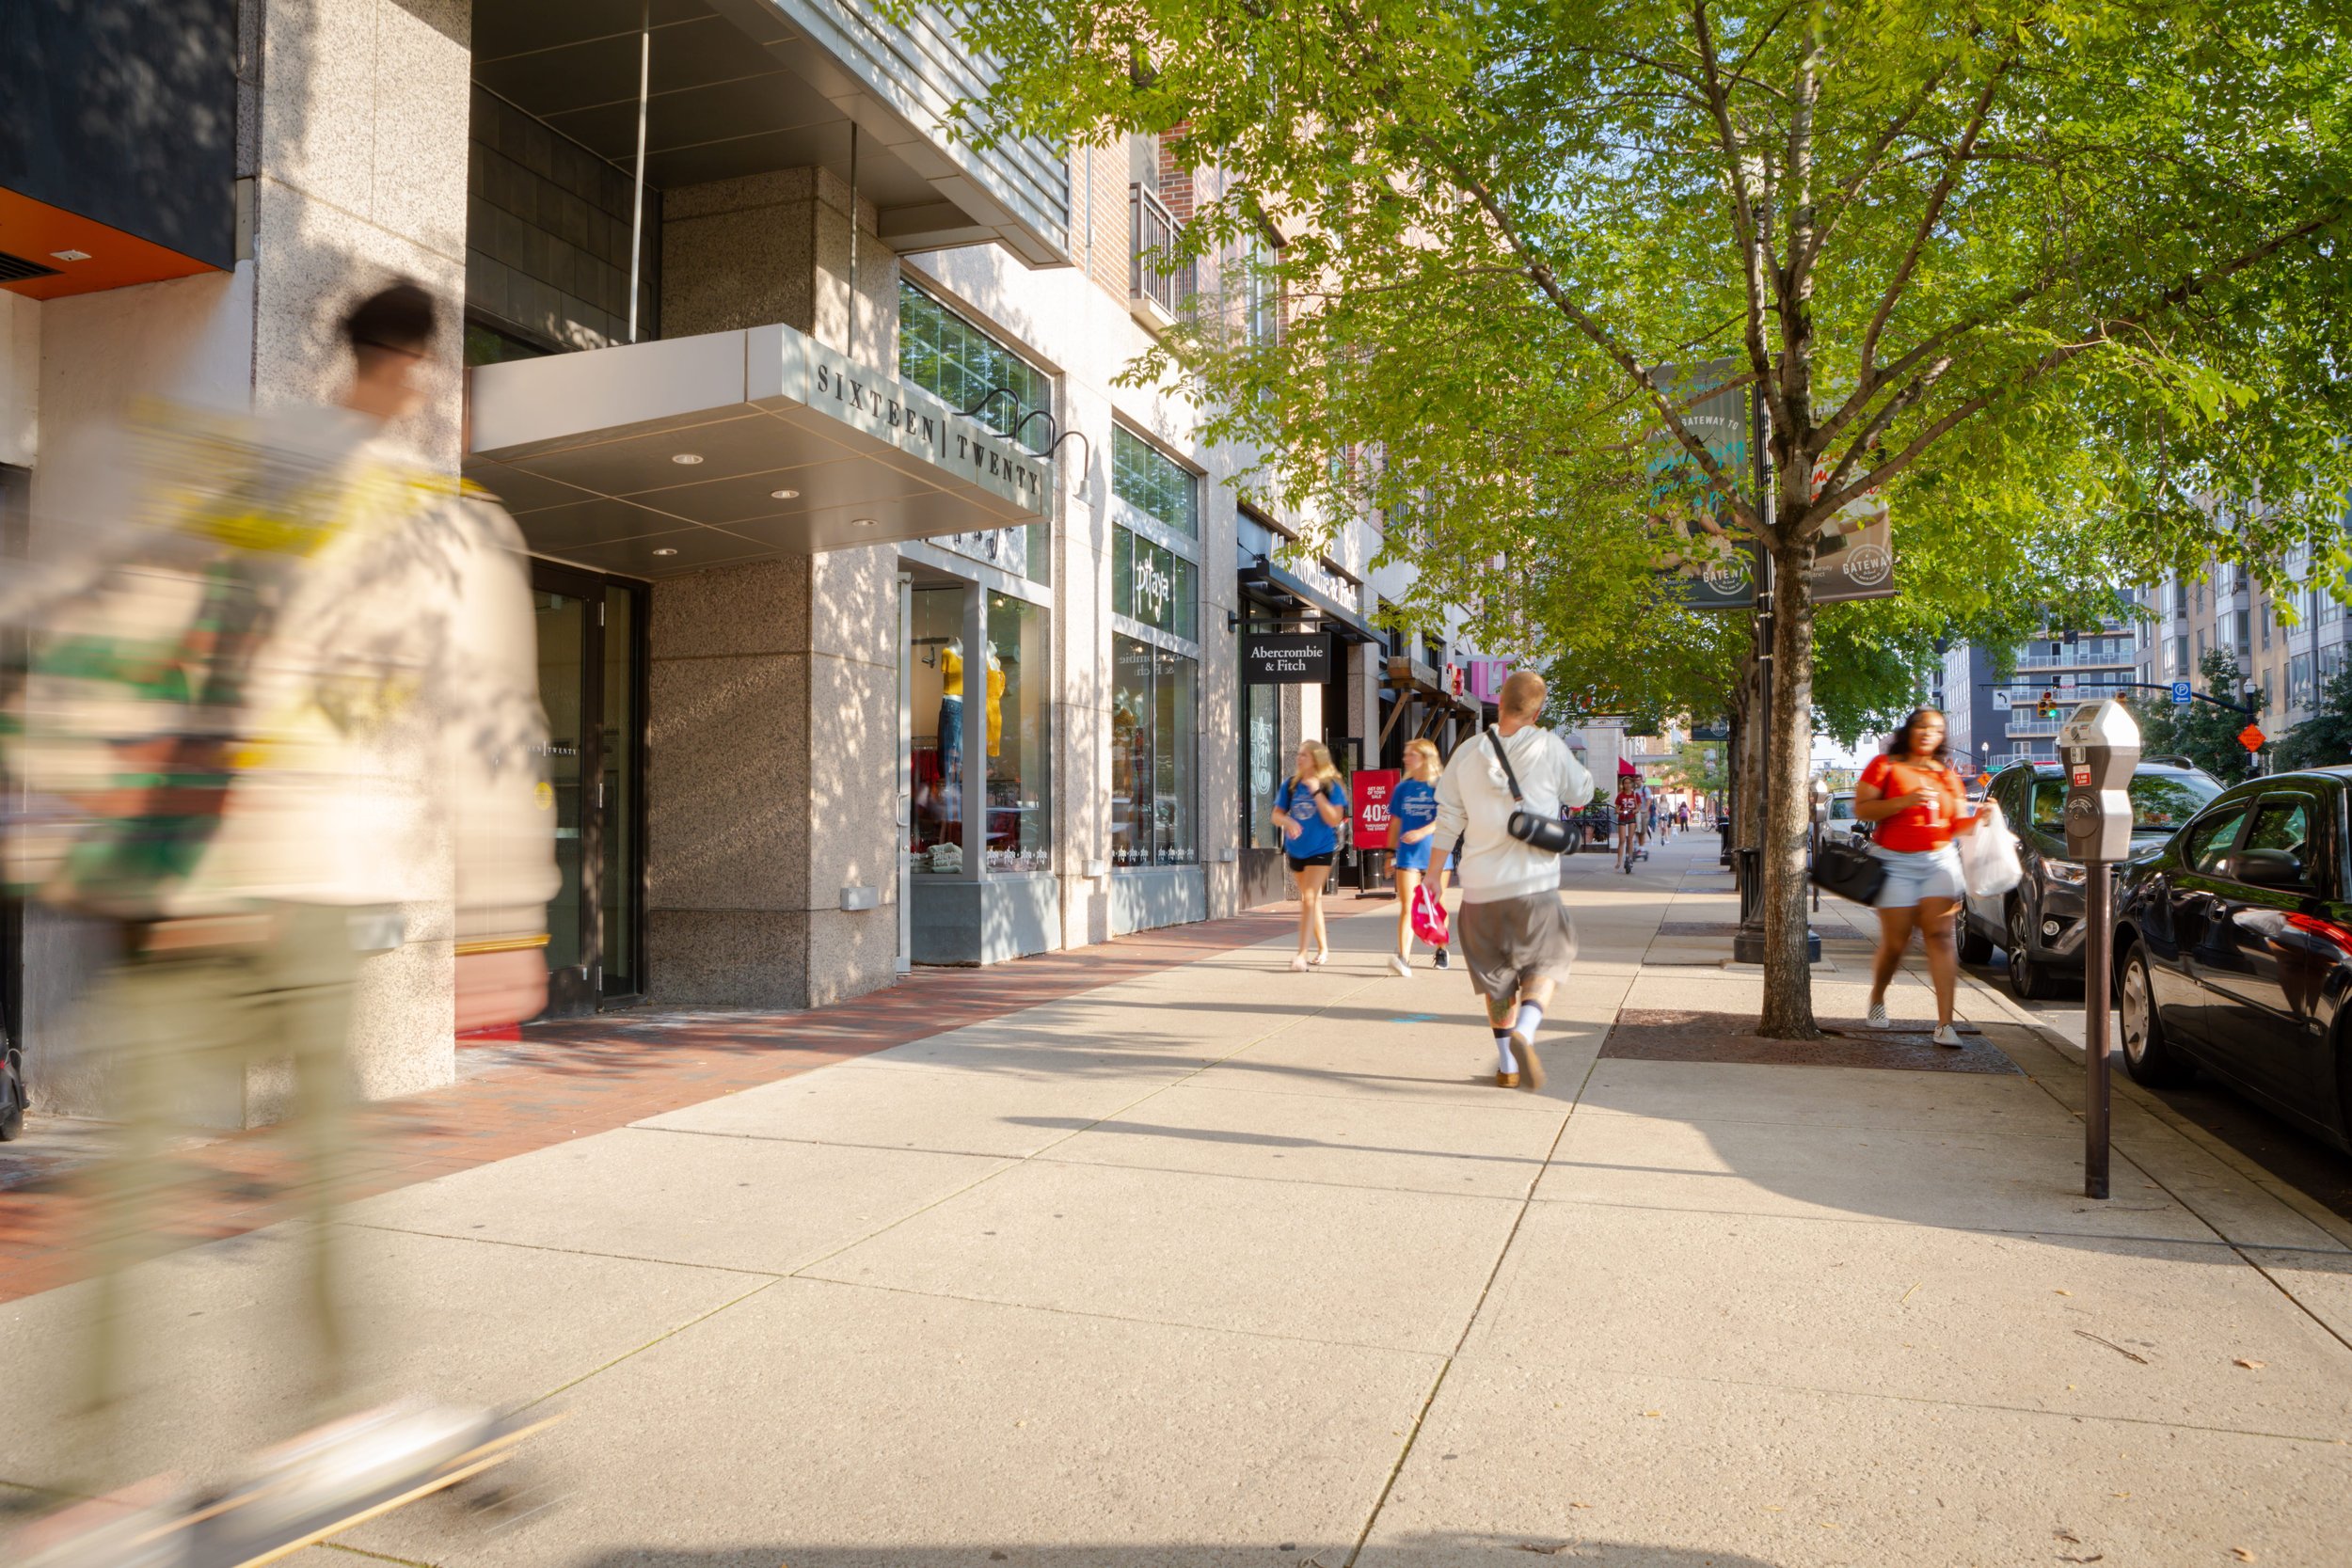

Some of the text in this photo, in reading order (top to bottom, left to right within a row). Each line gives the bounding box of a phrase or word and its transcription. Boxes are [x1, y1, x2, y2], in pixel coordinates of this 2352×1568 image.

[817, 364, 1039, 495] SIXTEEN TWENTY
[1728, 420, 1740, 430] TO
[1842, 554, 1894, 576] GATEWAY
[1136, 548, 1169, 623] pitaya
[1250, 645, 1323, 658] Abercrombie
[1264, 658, 1306, 671] & Fitch
[2178, 686, 2185, 695] P
[548, 746, 577, 755] TWENTY
